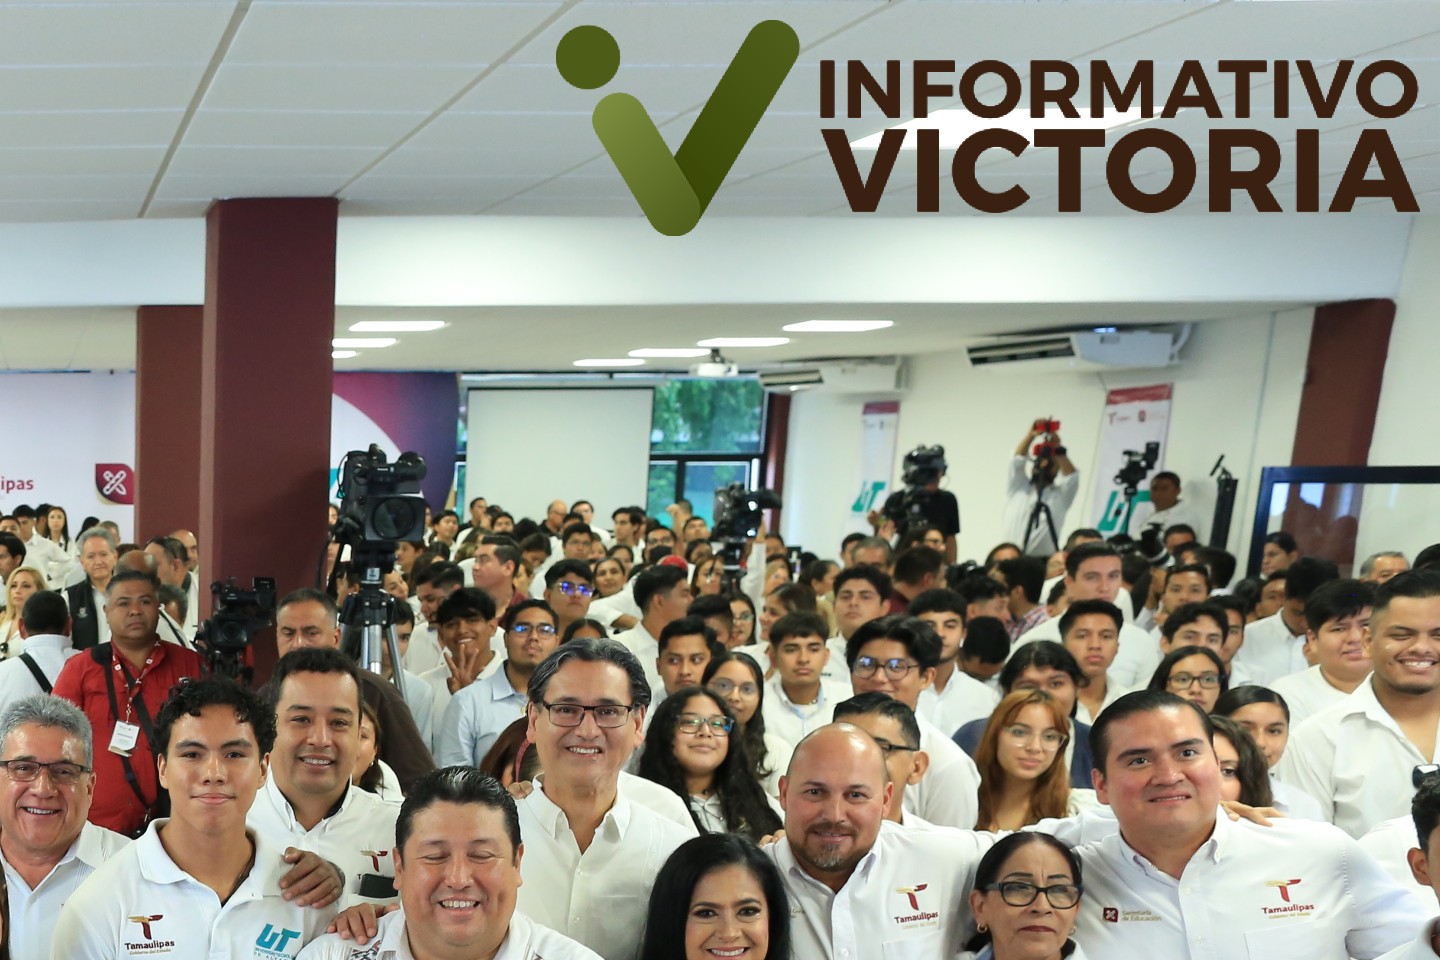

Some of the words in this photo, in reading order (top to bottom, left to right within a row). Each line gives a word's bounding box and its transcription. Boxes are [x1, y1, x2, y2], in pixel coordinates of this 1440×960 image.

[1261, 904, 1315, 914] Tamaulipas
[894, 912, 938, 924] Tamaulipas
[256, 923, 301, 952] UT
[124, 940, 175, 950] Tamaulipas
